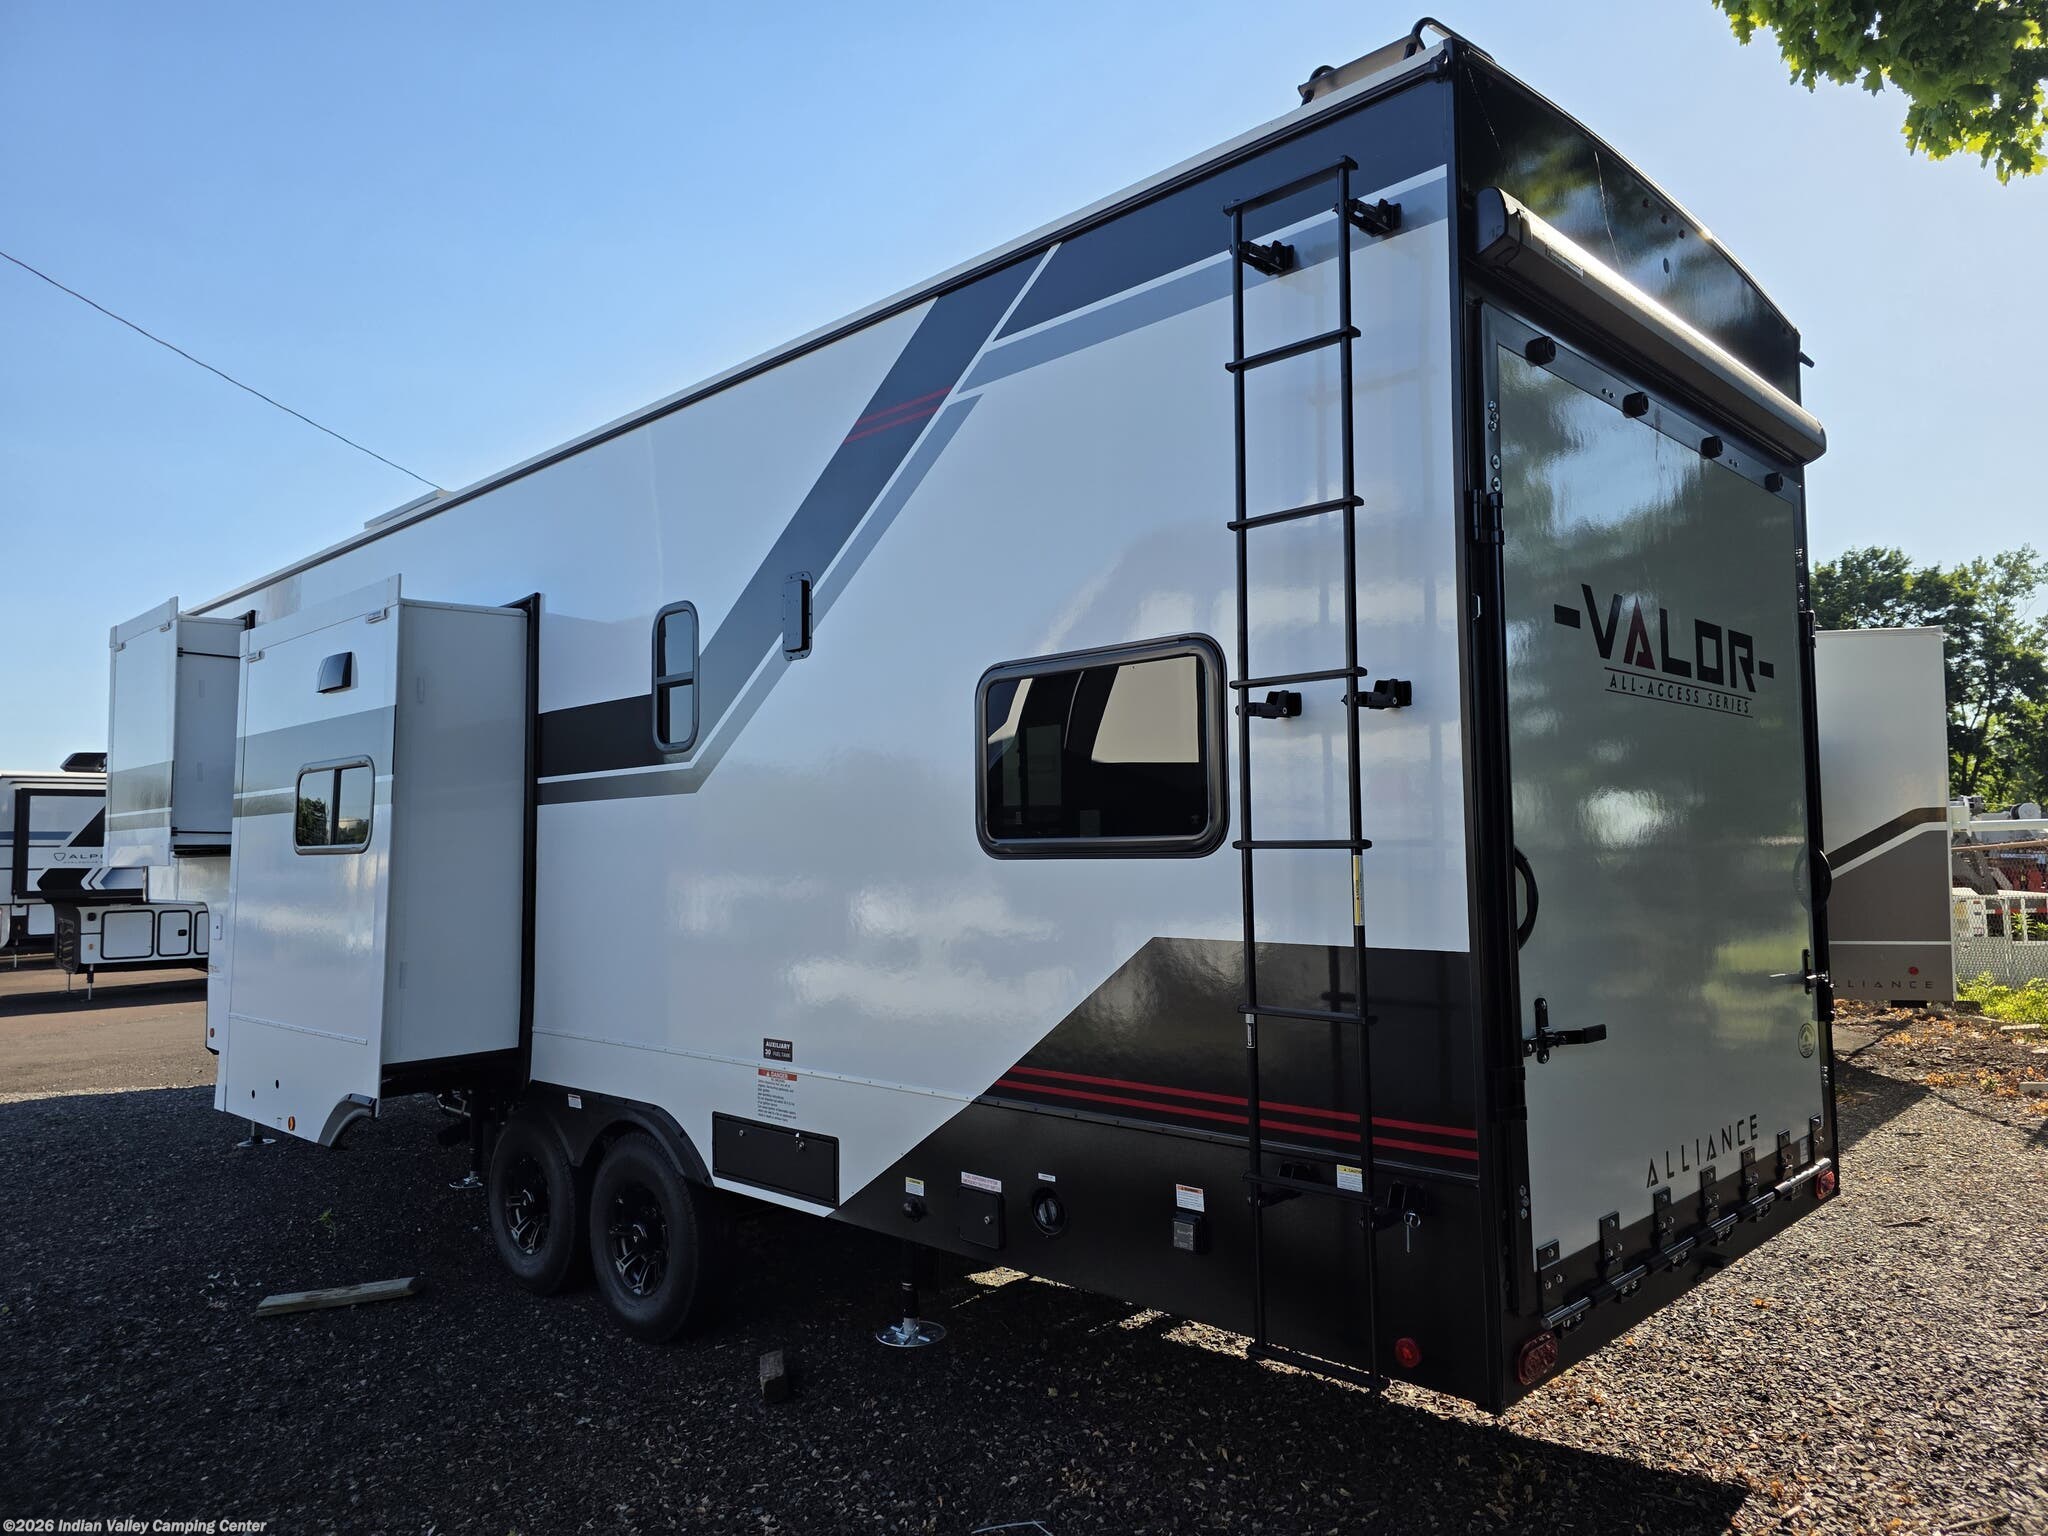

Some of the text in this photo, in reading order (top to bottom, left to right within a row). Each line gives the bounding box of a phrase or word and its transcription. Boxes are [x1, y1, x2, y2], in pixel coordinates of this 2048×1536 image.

[1610, 674, 1750, 714] ALL-ACCESS SERIES
[1832, 980, 1934, 990] LLIANCE
[765, 1041, 791, 1050] AUXILIARY
[1647, 1114, 1758, 1188] ALLIANCE
